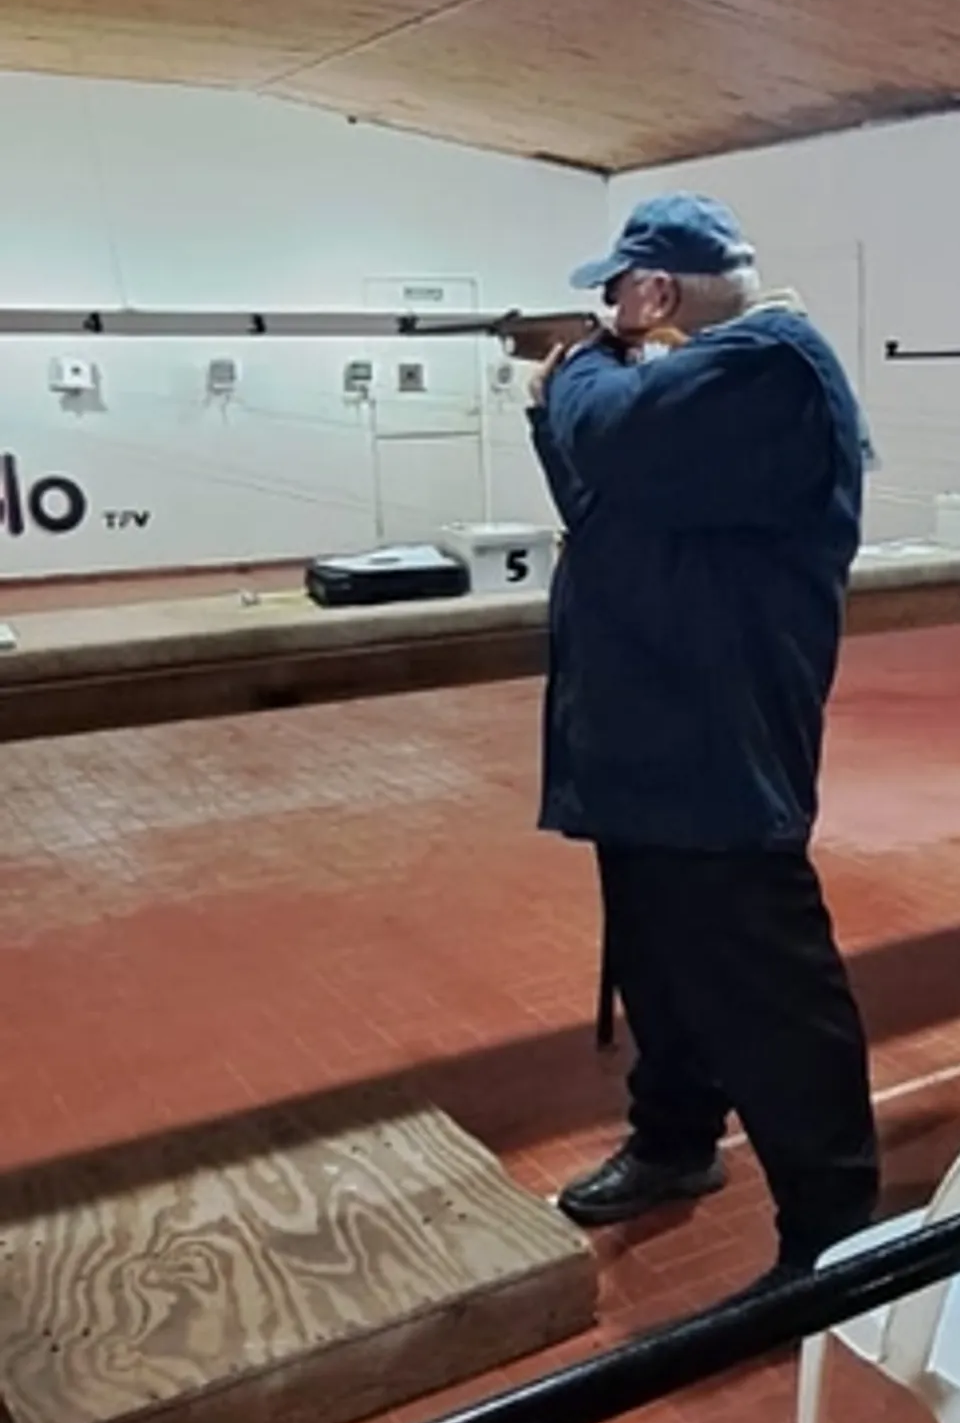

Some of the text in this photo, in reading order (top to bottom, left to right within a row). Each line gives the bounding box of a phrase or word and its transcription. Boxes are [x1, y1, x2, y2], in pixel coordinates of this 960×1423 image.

[82, 312, 104, 333] 4
[0, 452, 88, 538] lo
[505, 548, 529, 583] 5
